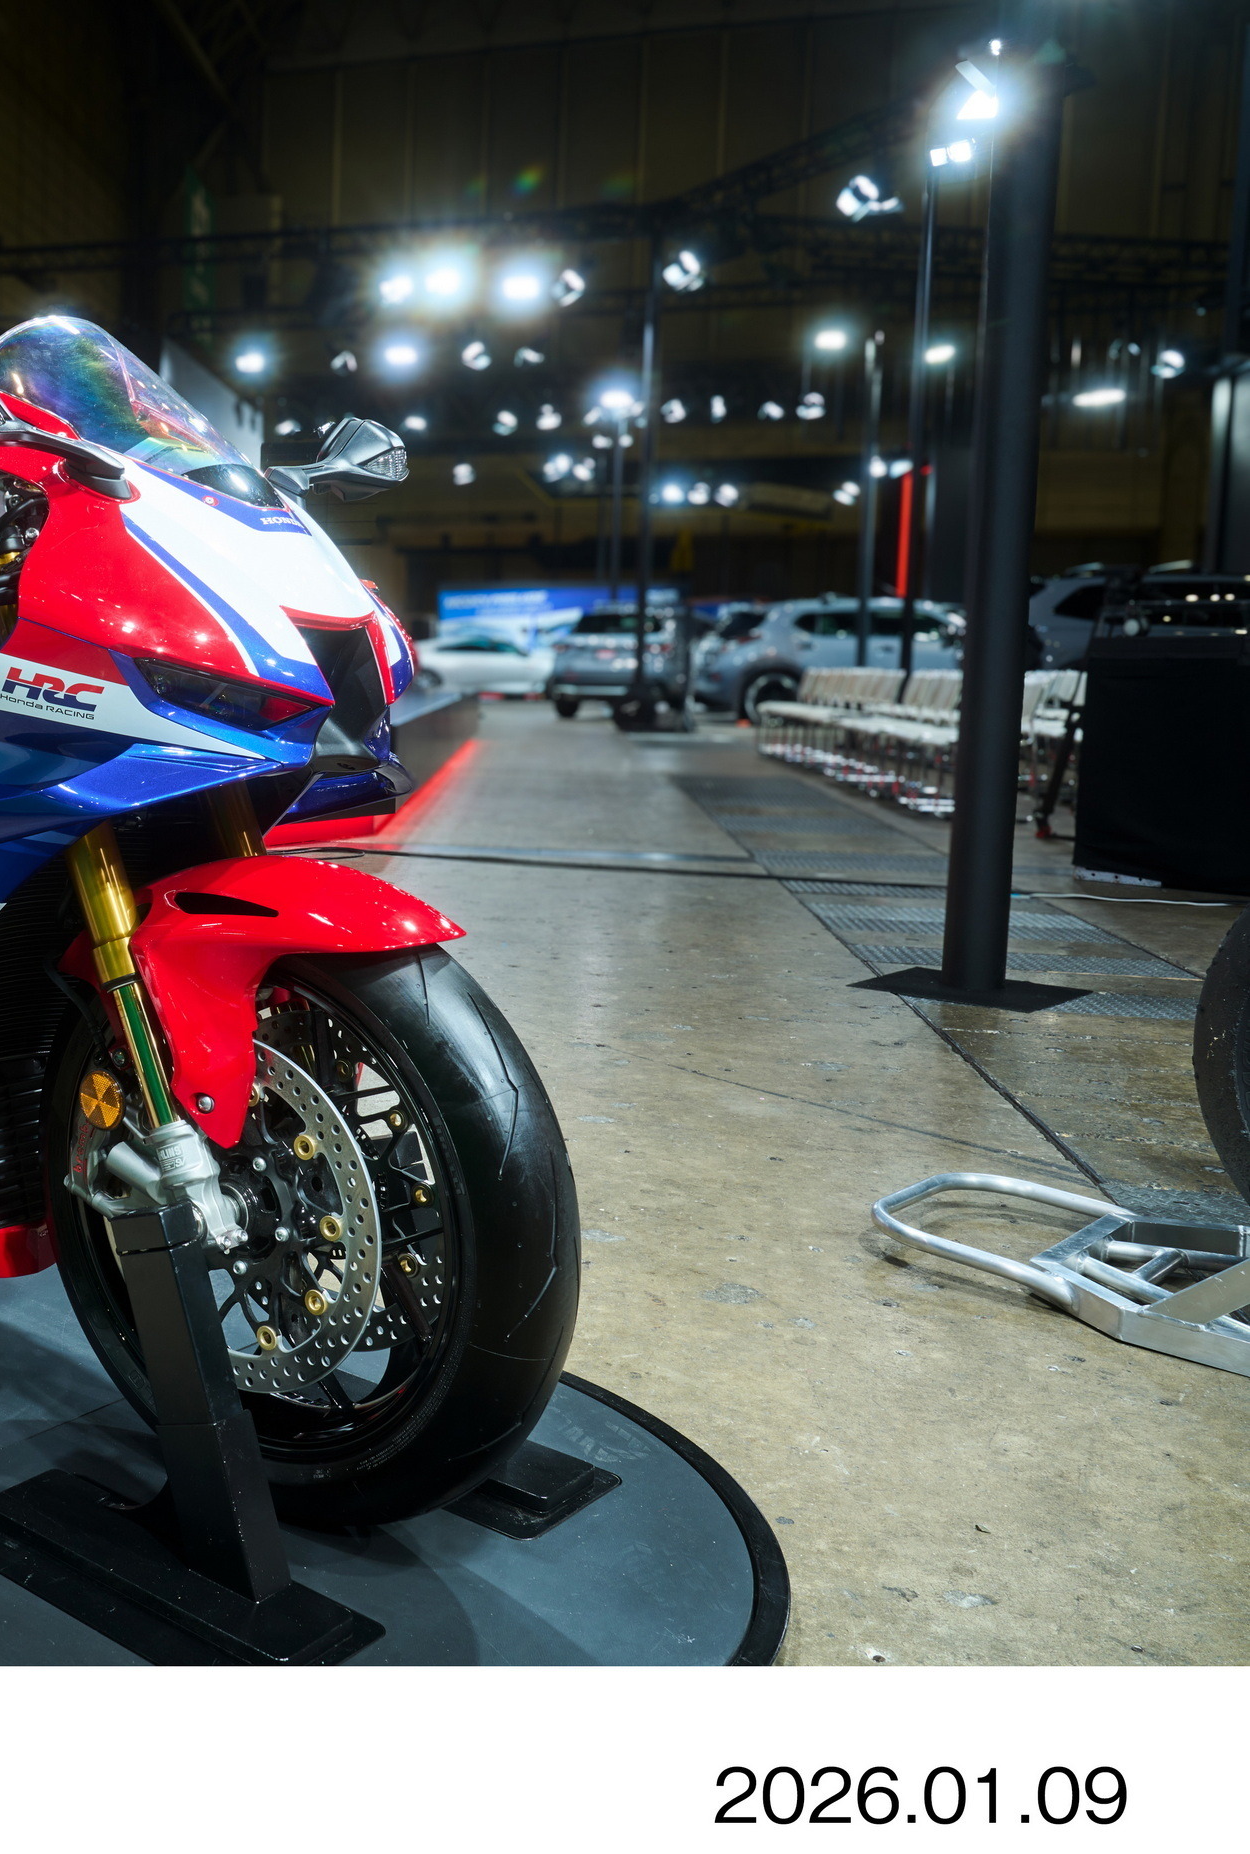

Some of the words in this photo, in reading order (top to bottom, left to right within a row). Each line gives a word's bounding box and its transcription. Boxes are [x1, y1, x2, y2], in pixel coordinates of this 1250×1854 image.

[0, 693, 43, 710] Honda
[45, 704, 95, 720] RACING
[2, 667, 105, 712] HRC
[73, 1120, 91, 1173] bremb
